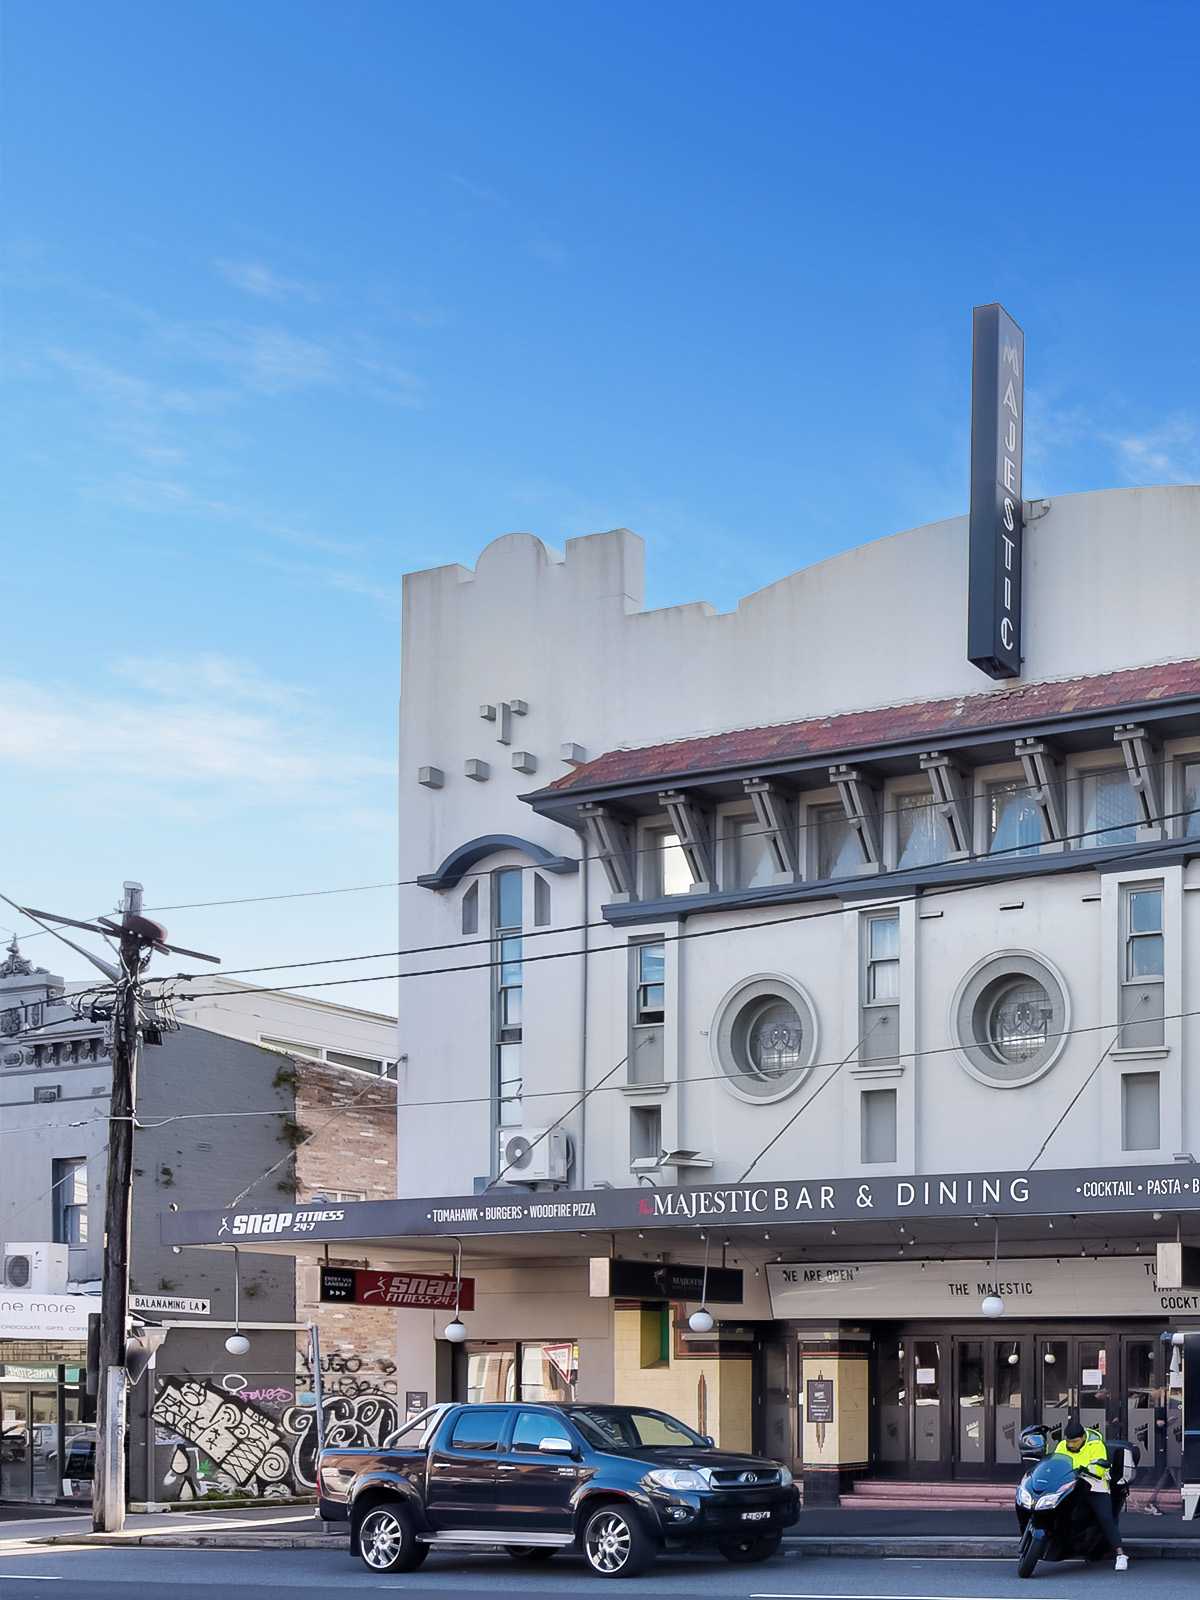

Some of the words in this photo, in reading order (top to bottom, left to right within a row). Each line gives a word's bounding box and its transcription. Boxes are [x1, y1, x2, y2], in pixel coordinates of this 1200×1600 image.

[1000, 342, 1019, 652] MAJESTIC
[1083, 1181, 1135, 1197] COCKTAIL
[1147, 1179, 1182, 1195] PASTA
[653, 1189, 768, 1218] MAJESTIC
[774, 1186, 835, 1211] BAR
[856, 1184, 874, 1208] &
[897, 1178, 1029, 1206] DINING
[295, 1210, 345, 1222] FITNESS
[433, 1208, 478, 1222] TOMAHAWK
[485, 1206, 522, 1220] BURGERS
[530, 1203, 571, 1218] WOODFIRE
[573, 1203, 596, 1216] PIZZA
[803, 1269, 822, 1281] ARE
[948, 1283, 969, 1296] THE
[977, 1282, 1033, 1297] MAJESTIC
[1, 1301, 24, 1312] ne
[30, 1302, 76, 1313] more
[135, 1297, 186, 1311] BALANAMING
[189, 1300, 200, 1311] LA
